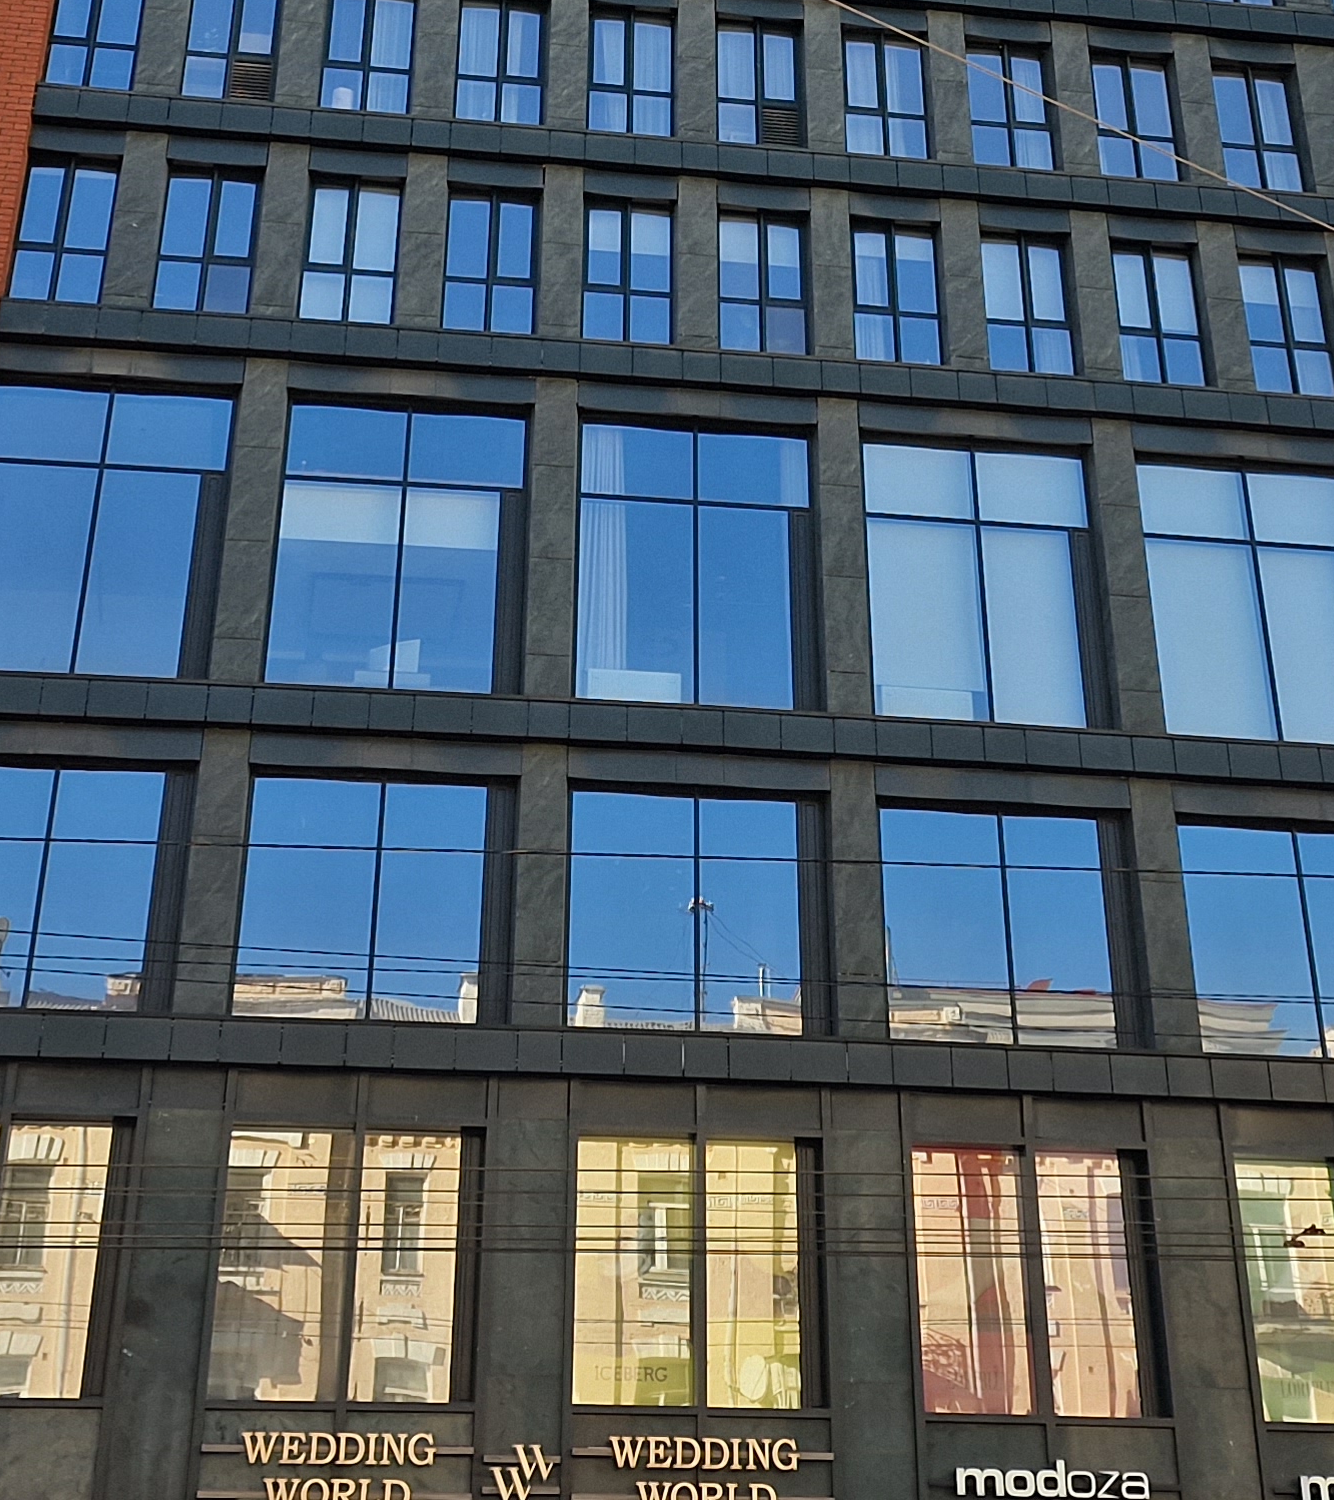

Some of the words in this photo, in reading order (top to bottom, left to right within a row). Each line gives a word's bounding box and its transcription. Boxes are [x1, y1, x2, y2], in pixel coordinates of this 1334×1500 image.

[594, 1365, 668, 1383] ICEBERG
[241, 1431, 438, 1467] WEDDING
[609, 1435, 801, 1472] WEDDING
[955, 1458, 1151, 1500] modoza
